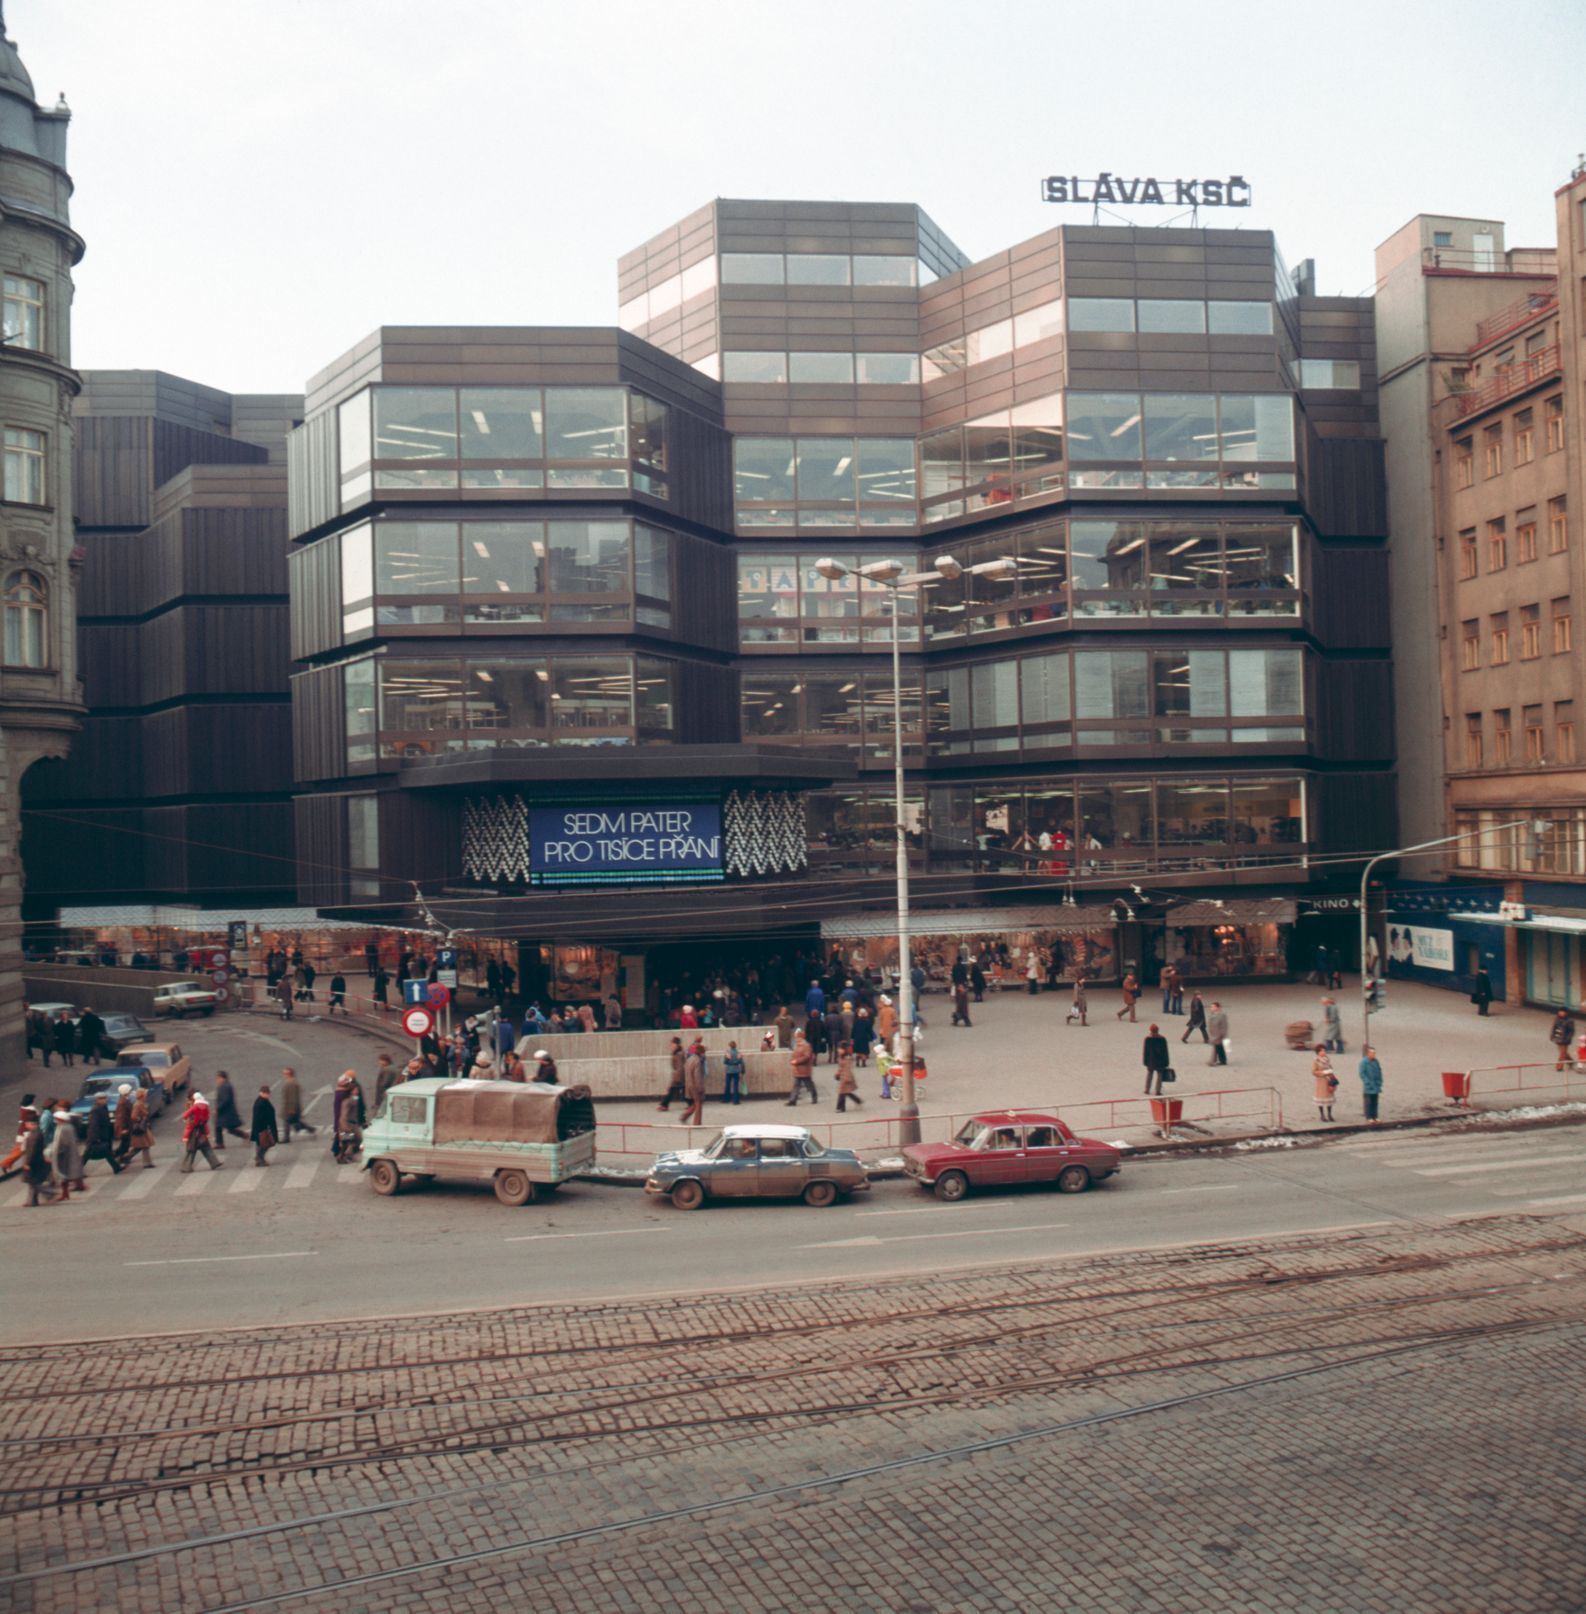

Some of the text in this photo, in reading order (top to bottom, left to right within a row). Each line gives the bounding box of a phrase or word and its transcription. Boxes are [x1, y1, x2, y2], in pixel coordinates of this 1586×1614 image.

[1047, 172, 1249, 207] SLÁVA KSČ
[564, 811, 692, 835] SEDM PATER
[544, 833, 721, 863] PRO TISÍCE PŘÁNÍ
[1313, 898, 1349, 909] KINO
[442, 951, 452, 962] P
